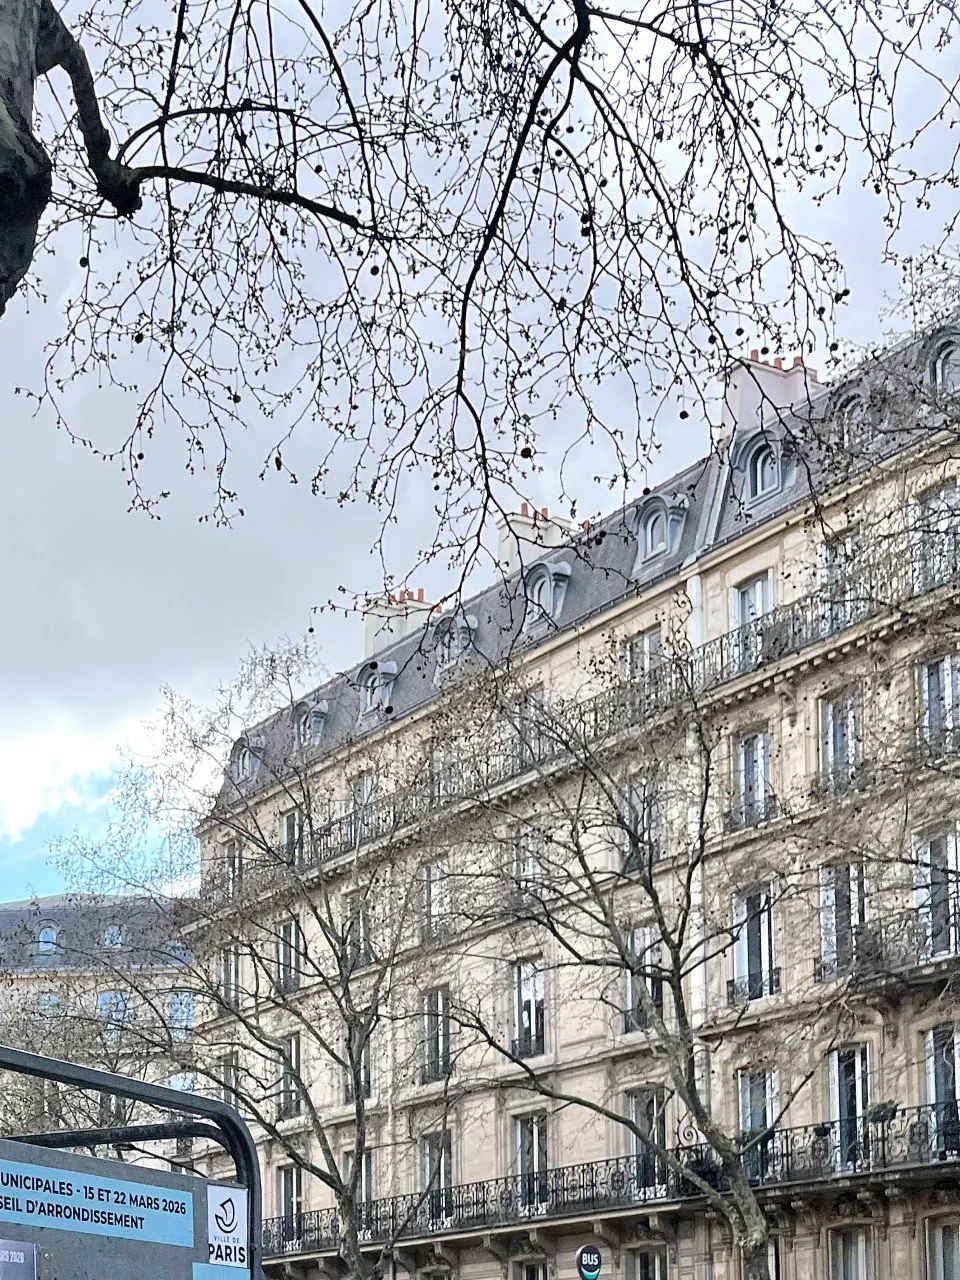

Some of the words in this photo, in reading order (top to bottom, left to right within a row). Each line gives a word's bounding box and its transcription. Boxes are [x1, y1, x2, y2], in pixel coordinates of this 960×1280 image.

[83, 1185, 95, 1201] 15
[98, 1187, 111, 1203] ET
[114, 1189, 127, 1205] 22
[129, 1193, 160, 1211] MARS
[162, 1197, 187, 1215] 2026
[26, 1197, 145, 1230] D'ARRONDISSEMENT
[208, 1243, 246, 1263] PARIS
[582, 1253, 599, 1266] BUS
